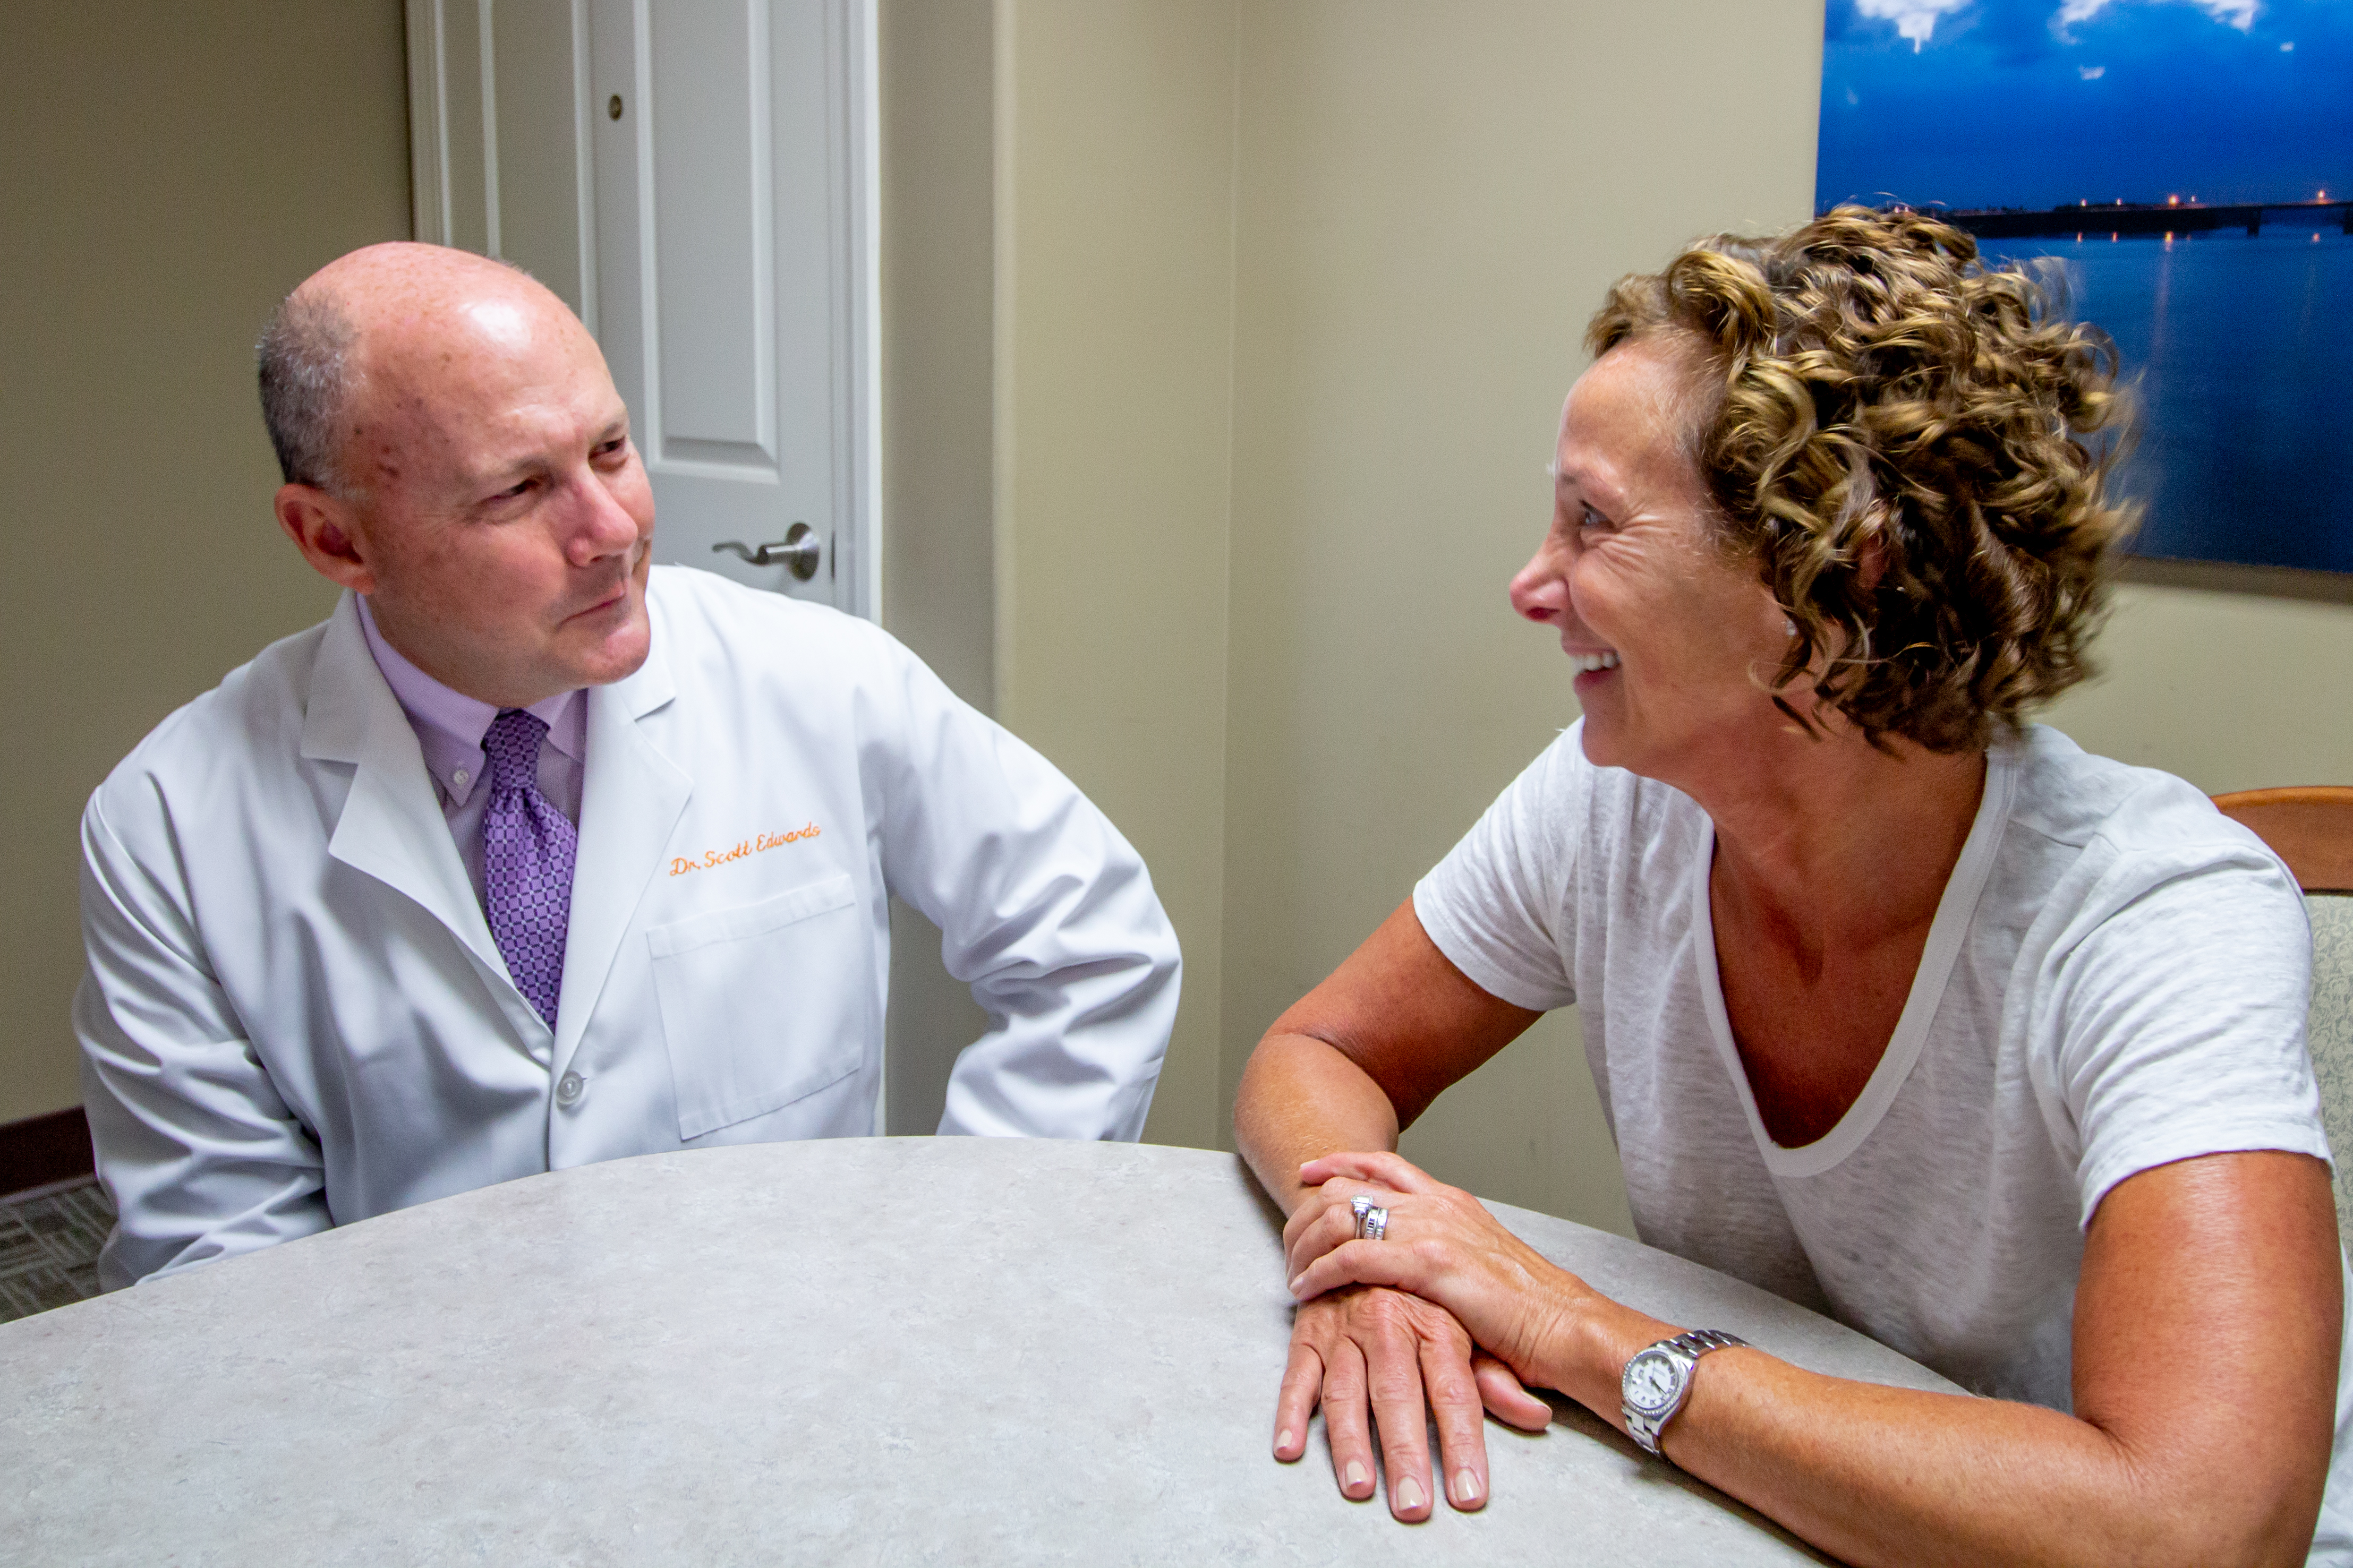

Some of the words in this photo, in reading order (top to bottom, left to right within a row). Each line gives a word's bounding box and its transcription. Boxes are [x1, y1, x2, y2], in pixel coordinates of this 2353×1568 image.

[669, 857, 701, 876] Dr.
[704, 841, 753, 868] Scott
[756, 821, 821, 852] Edwards
